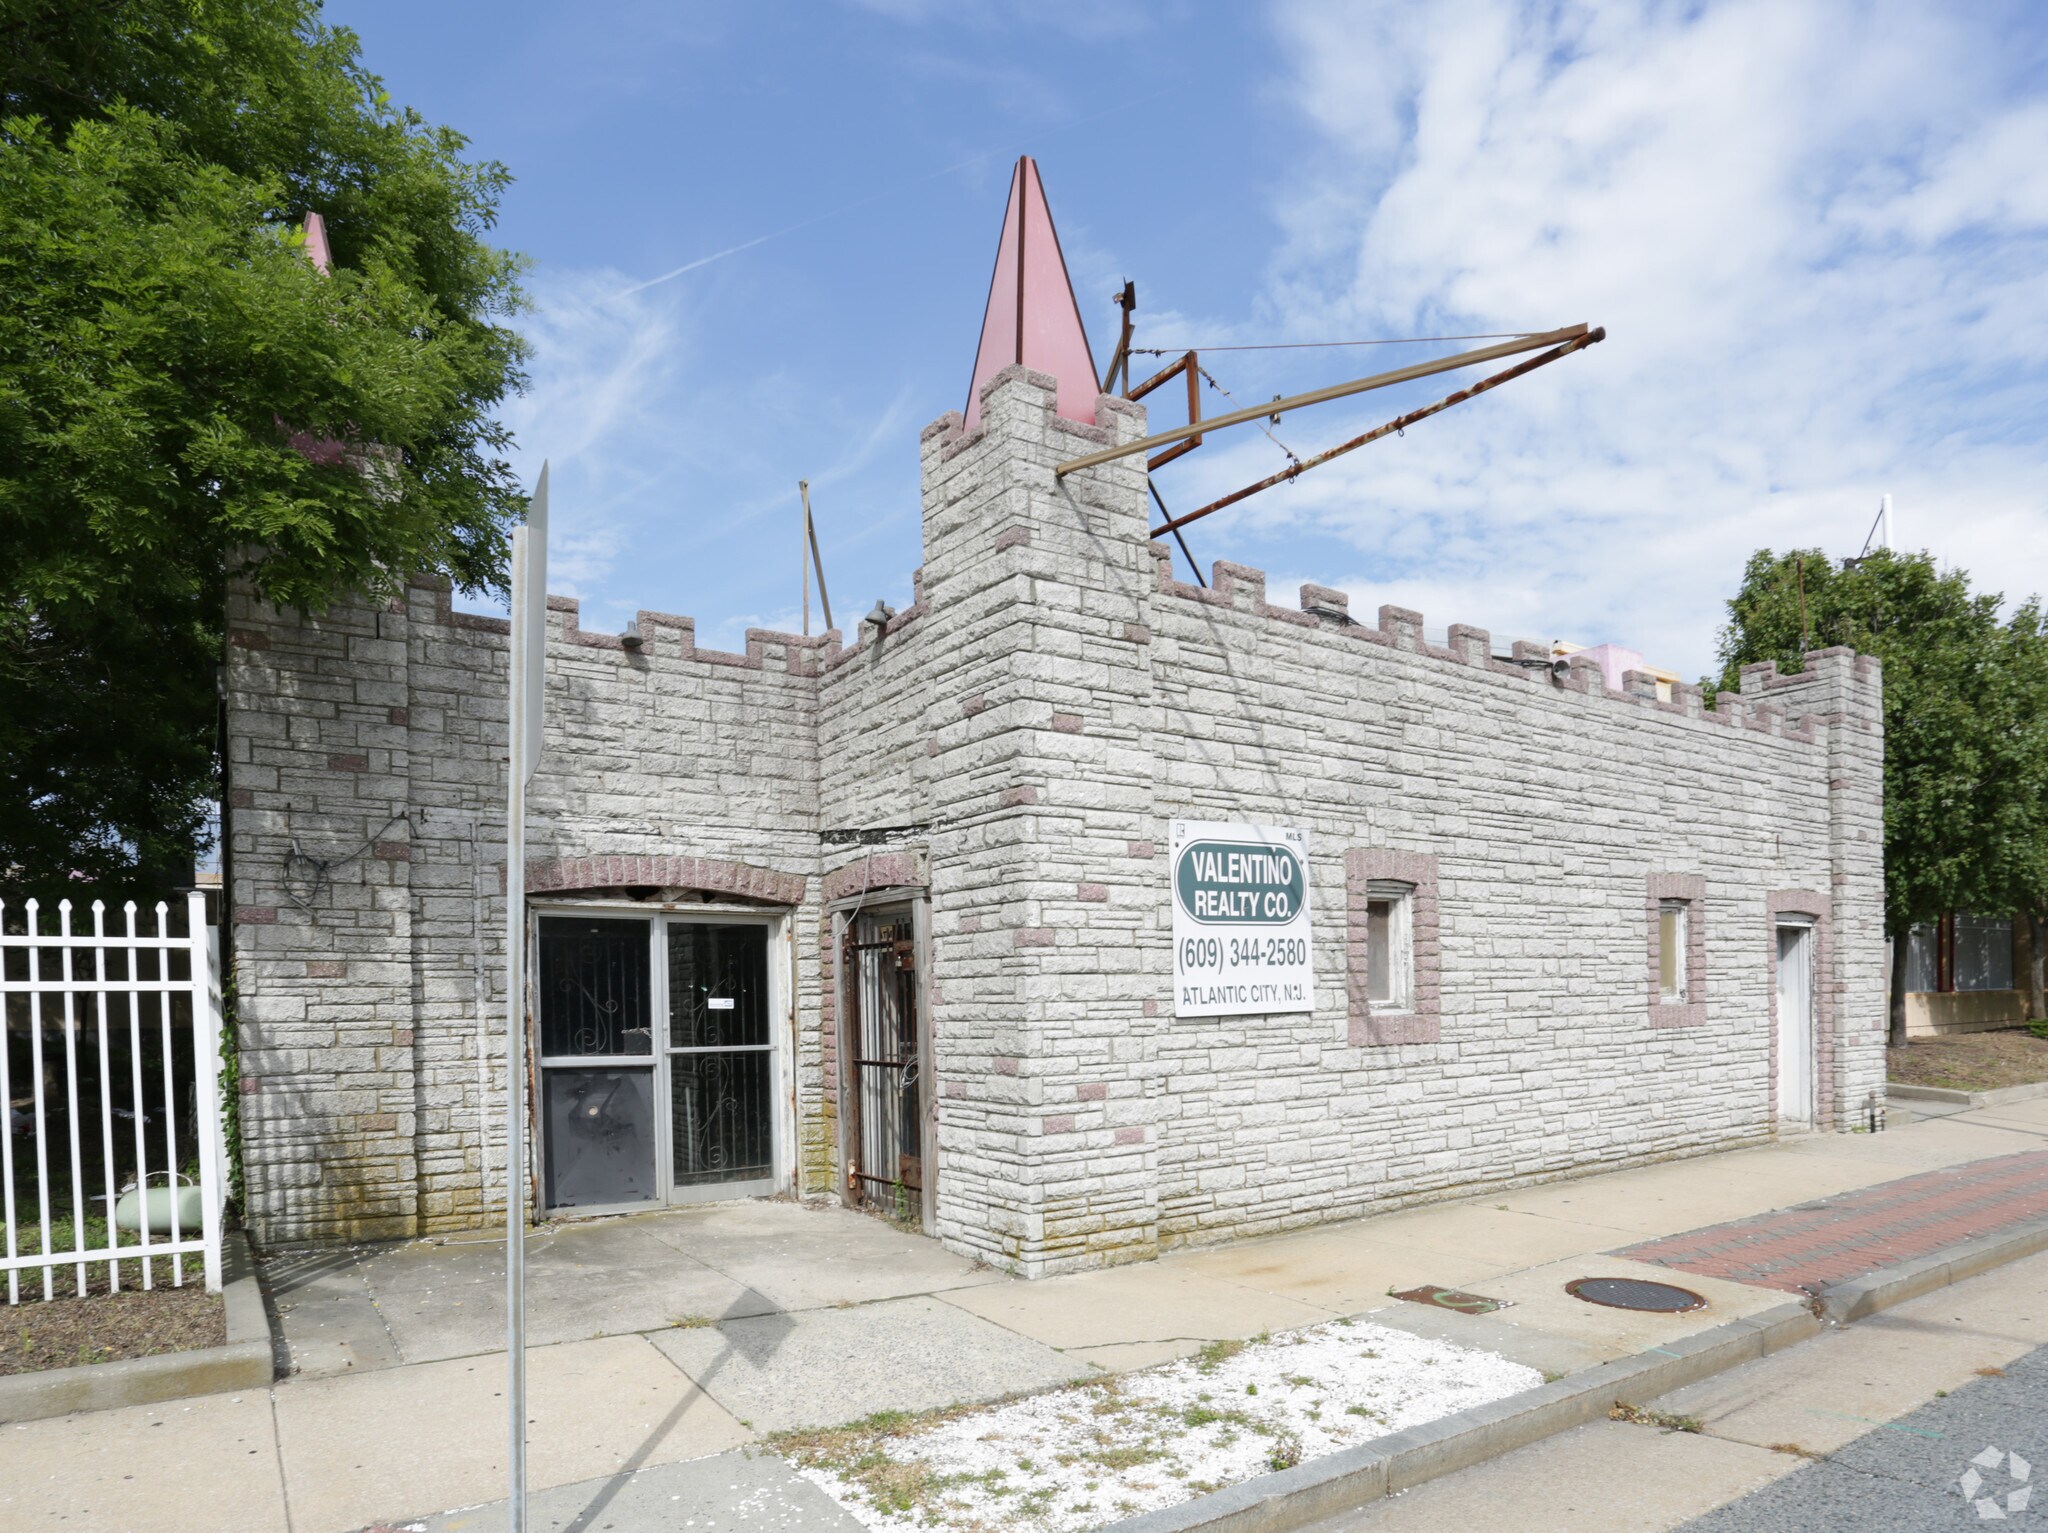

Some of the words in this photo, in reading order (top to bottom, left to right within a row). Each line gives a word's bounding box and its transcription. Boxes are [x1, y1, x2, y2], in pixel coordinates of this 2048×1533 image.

[1286, 832, 1302, 842] MLS
[1191, 851, 1292, 886] VALENTINO
[1194, 890, 1261, 917] REALTY
[1264, 892, 1292, 918] CO.
[1179, 937, 1224, 976] (609)
[1230, 938, 1306, 967] 344-2580
[1182, 985, 1247, 1005] ATLANTIC
[1250, 984, 1282, 1004] CITY,
